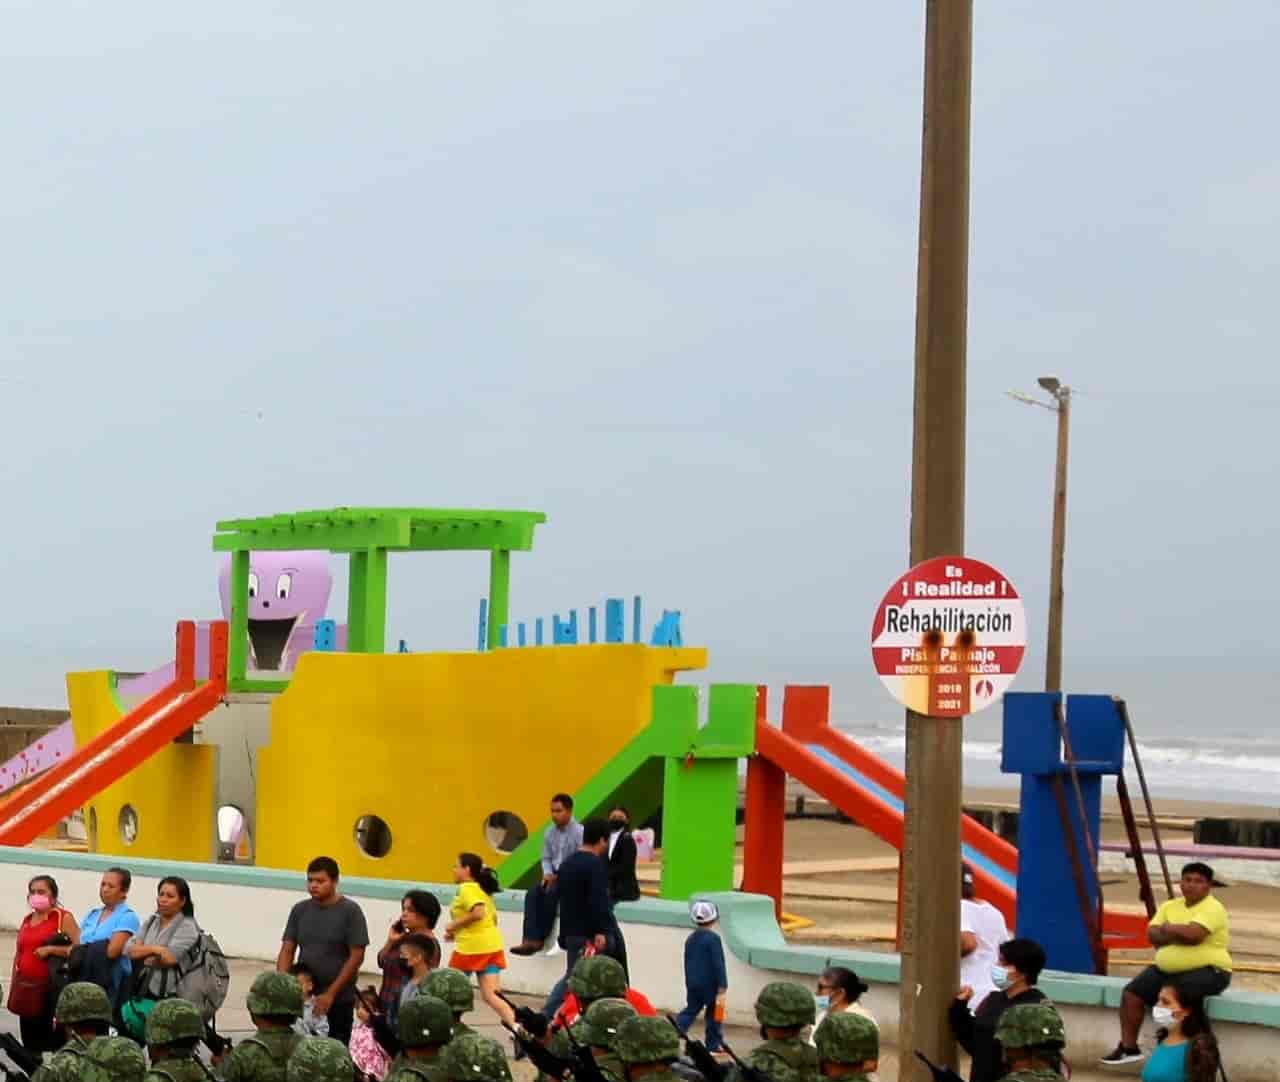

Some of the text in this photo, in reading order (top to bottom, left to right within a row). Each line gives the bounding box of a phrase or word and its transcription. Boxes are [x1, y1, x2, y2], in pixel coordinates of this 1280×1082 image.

[945, 566, 963, 577] Es
[915, 581, 995, 596] Realidad
[887, 607, 1012, 633] Rehabilitación
[901, 647, 996, 664] Pist Panaje
